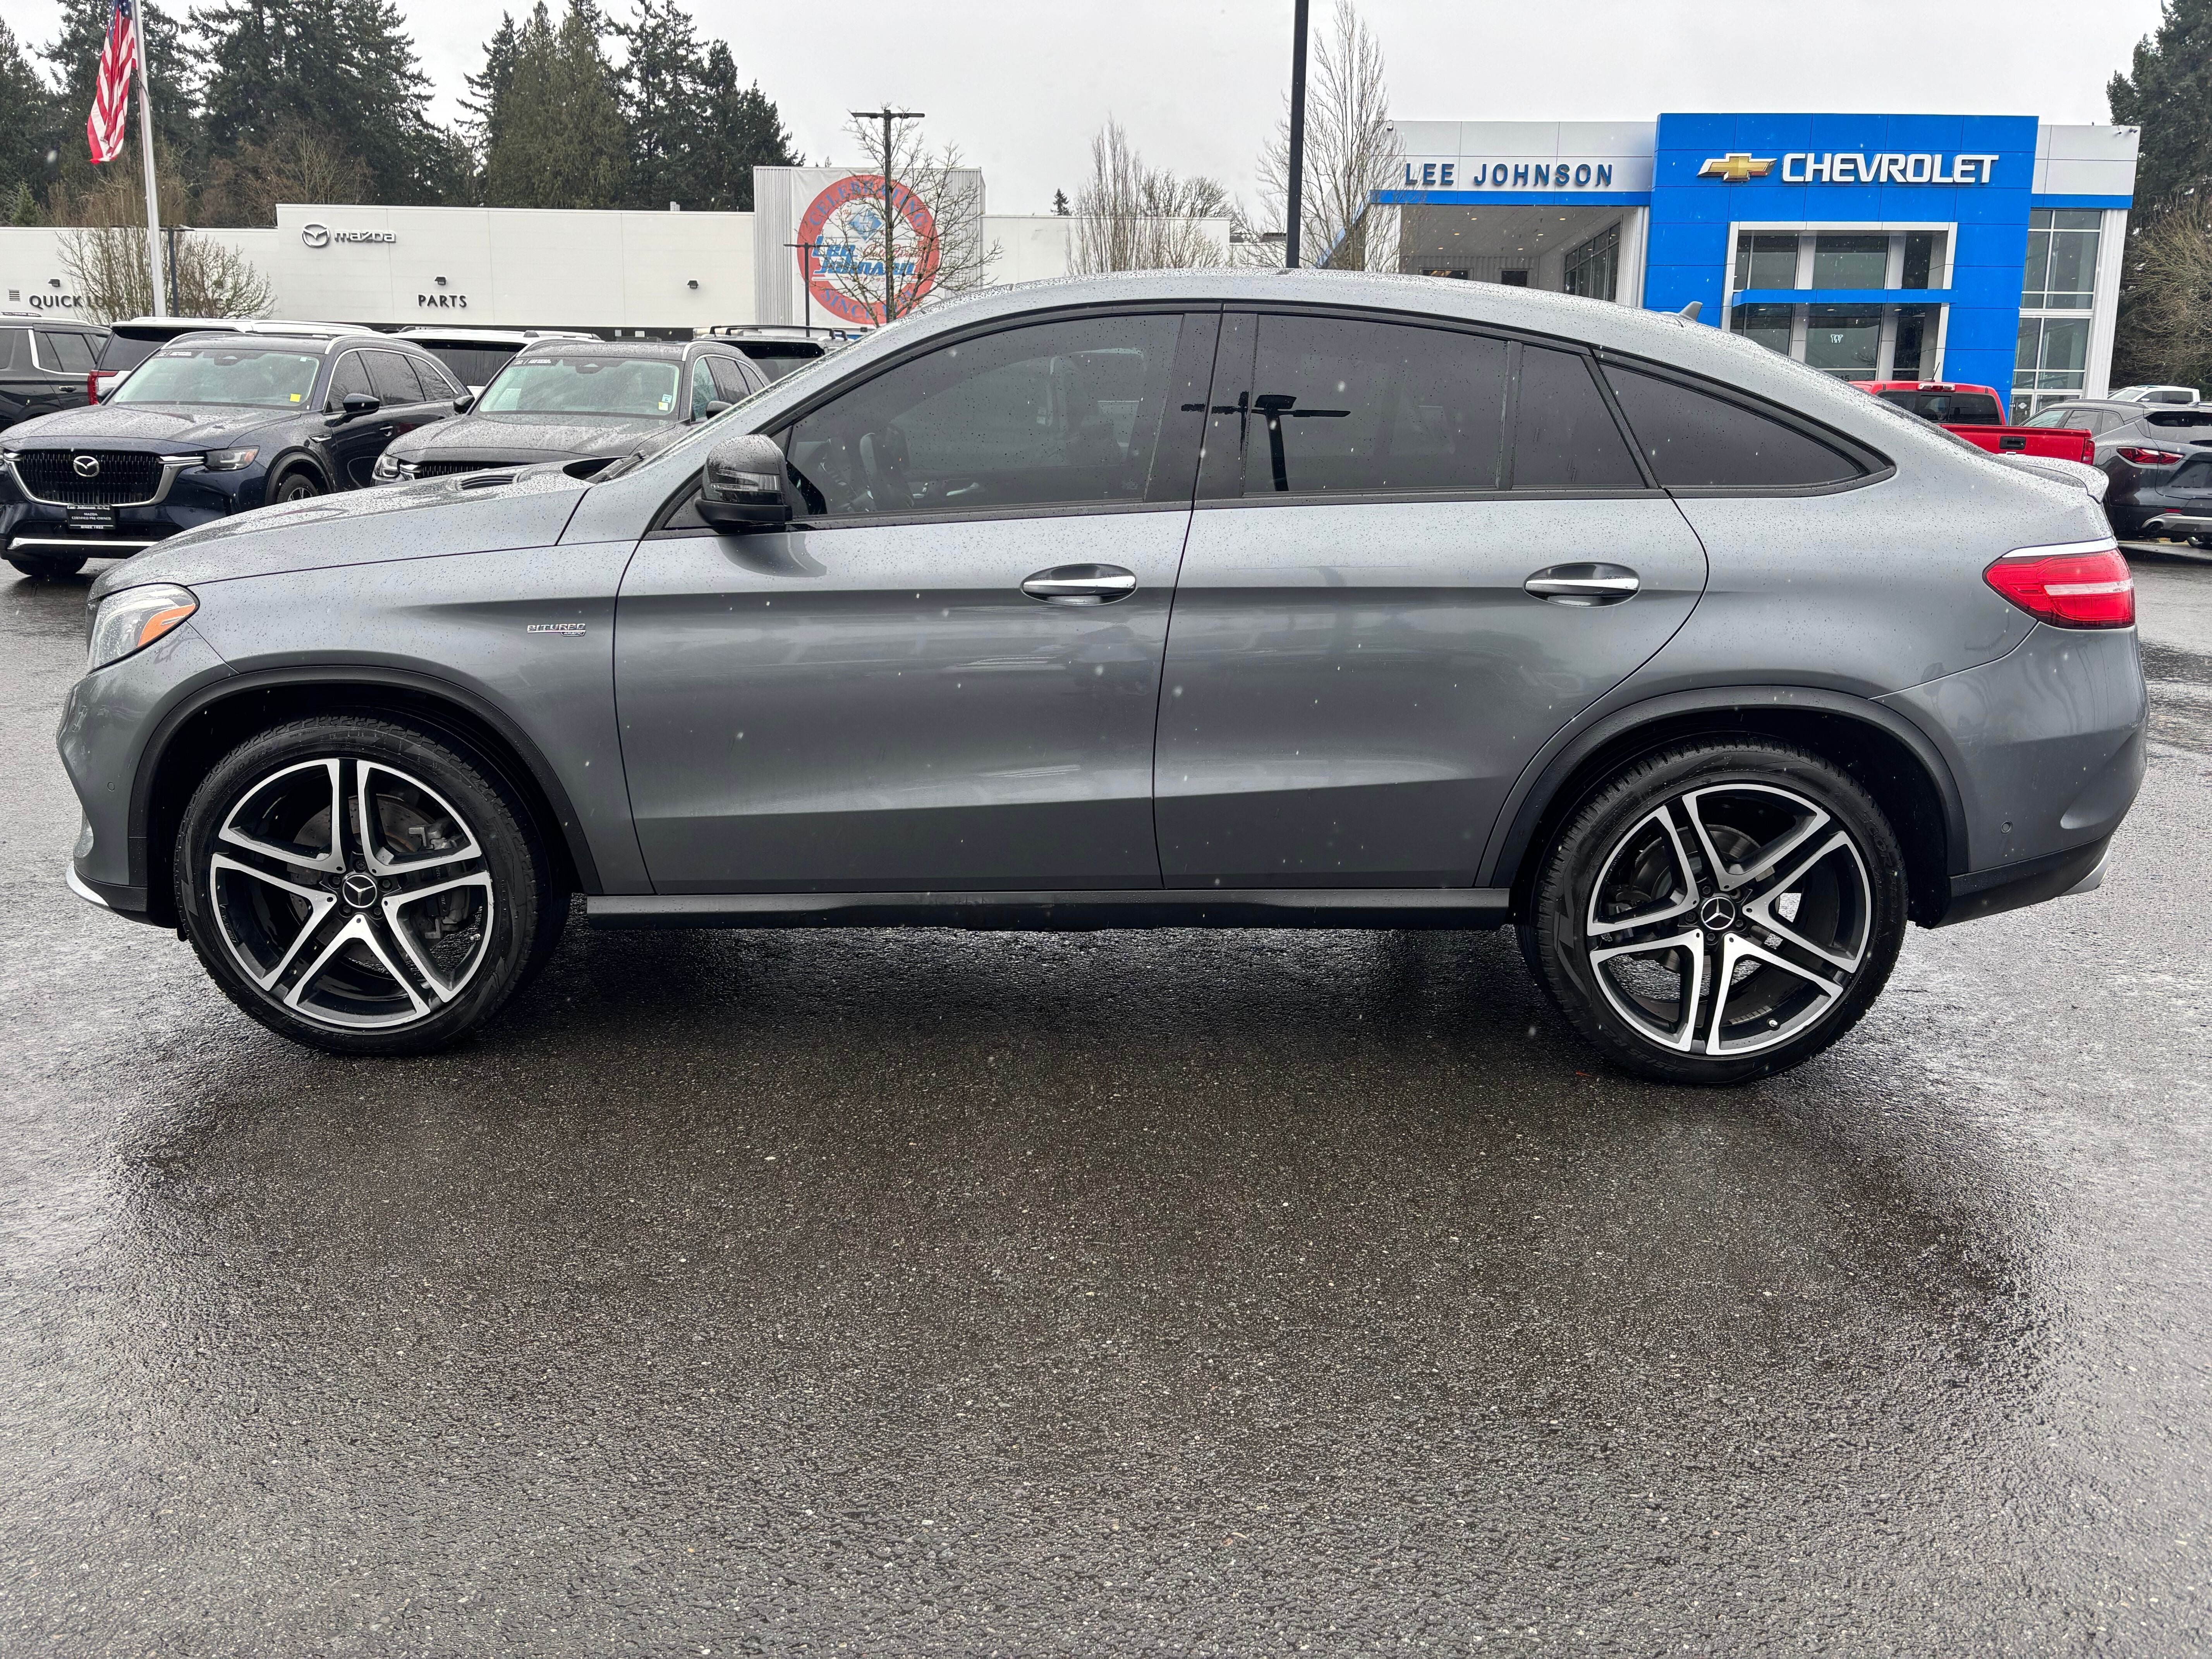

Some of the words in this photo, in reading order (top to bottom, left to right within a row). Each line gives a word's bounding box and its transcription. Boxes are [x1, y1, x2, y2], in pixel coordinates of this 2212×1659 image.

[1405, 163, 1455, 185] LEE
[1474, 163, 1613, 186] JOHNSON
[1781, 153, 2000, 184] CHEVROLET
[29, 295, 83, 310] QUICK
[418, 294, 467, 307] PARTS
